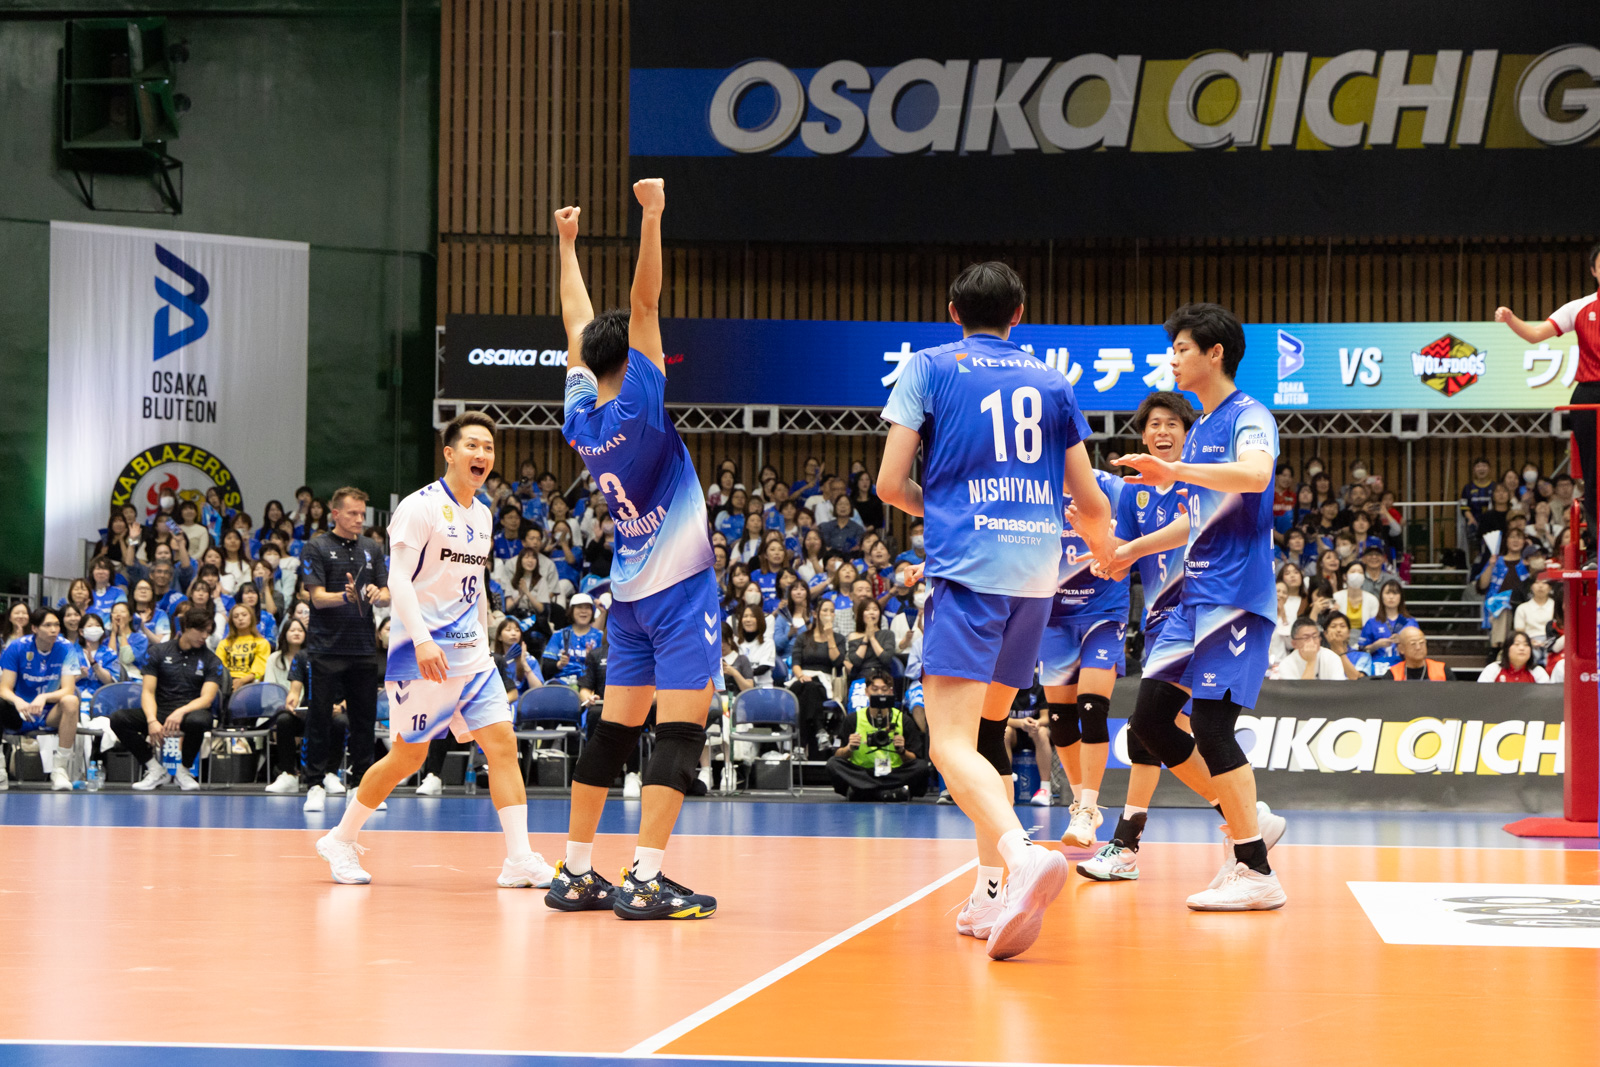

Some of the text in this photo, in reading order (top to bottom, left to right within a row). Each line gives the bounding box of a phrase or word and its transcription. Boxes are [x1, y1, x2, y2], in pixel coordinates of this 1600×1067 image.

[971, 357, 1048, 372] KEIHAN
[1339, 347, 1383, 386] VS
[1411, 350, 1487, 376] WOLFDOGS
[152, 371, 208, 397] OSAKA
[142, 396, 217, 423] BLUTEON
[980, 386, 1042, 464] 18
[577, 433, 627, 456] KEIHAN
[1202, 445, 1225, 453] Bistro
[599, 472, 639, 520] 3
[1188, 494, 1201, 528] 19
[974, 514, 1057, 535] Panasonic
[997, 534, 1042, 546] INDUSTRY
[1066, 544, 1078, 566] 8
[1157, 554, 1168, 582] 5
[459, 575, 477, 604] 16
[411, 713, 428, 731] 16
